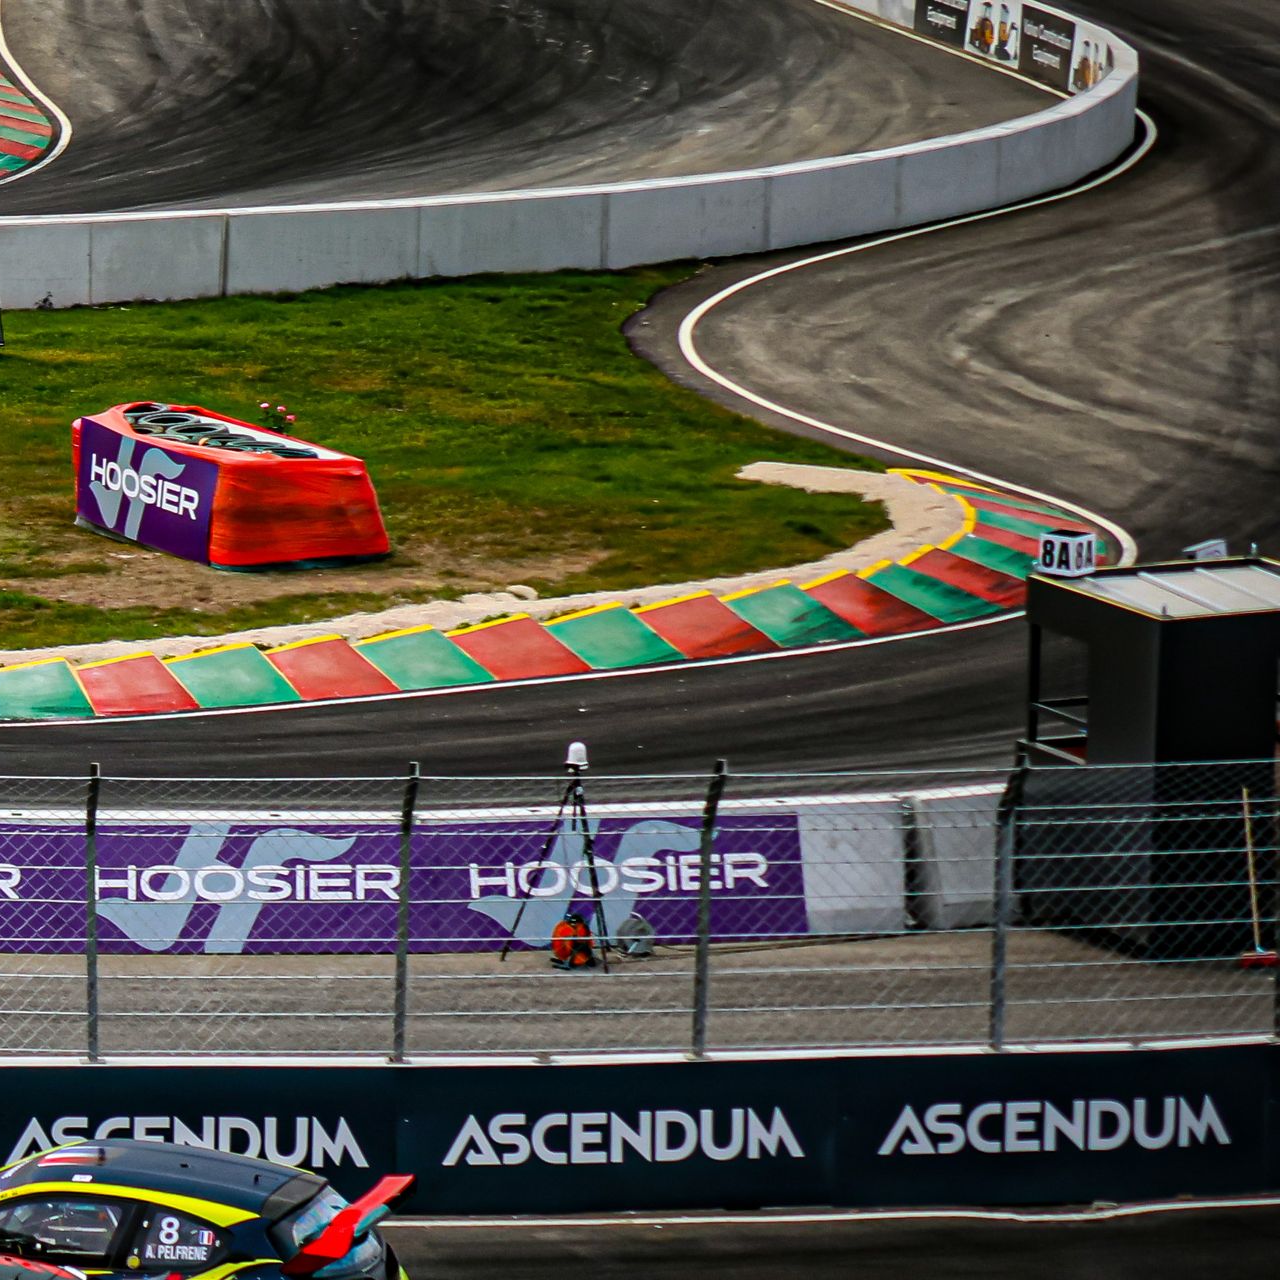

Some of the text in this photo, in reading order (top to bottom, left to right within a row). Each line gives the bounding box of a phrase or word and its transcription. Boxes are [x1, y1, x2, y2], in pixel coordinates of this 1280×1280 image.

[91, 453, 199, 520] HOOSIER
[1042, 539, 1071, 571] 8A
[93, 863, 402, 902] HOOSIER
[469, 851, 770, 900] HOOSIER
[442, 1107, 805, 1166] ASCENDUM
[877, 1094, 1233, 1156] ASCENDUM
[158, 1216, 180, 1245] 8
[157, 1245, 208, 1262] PELFRENE
